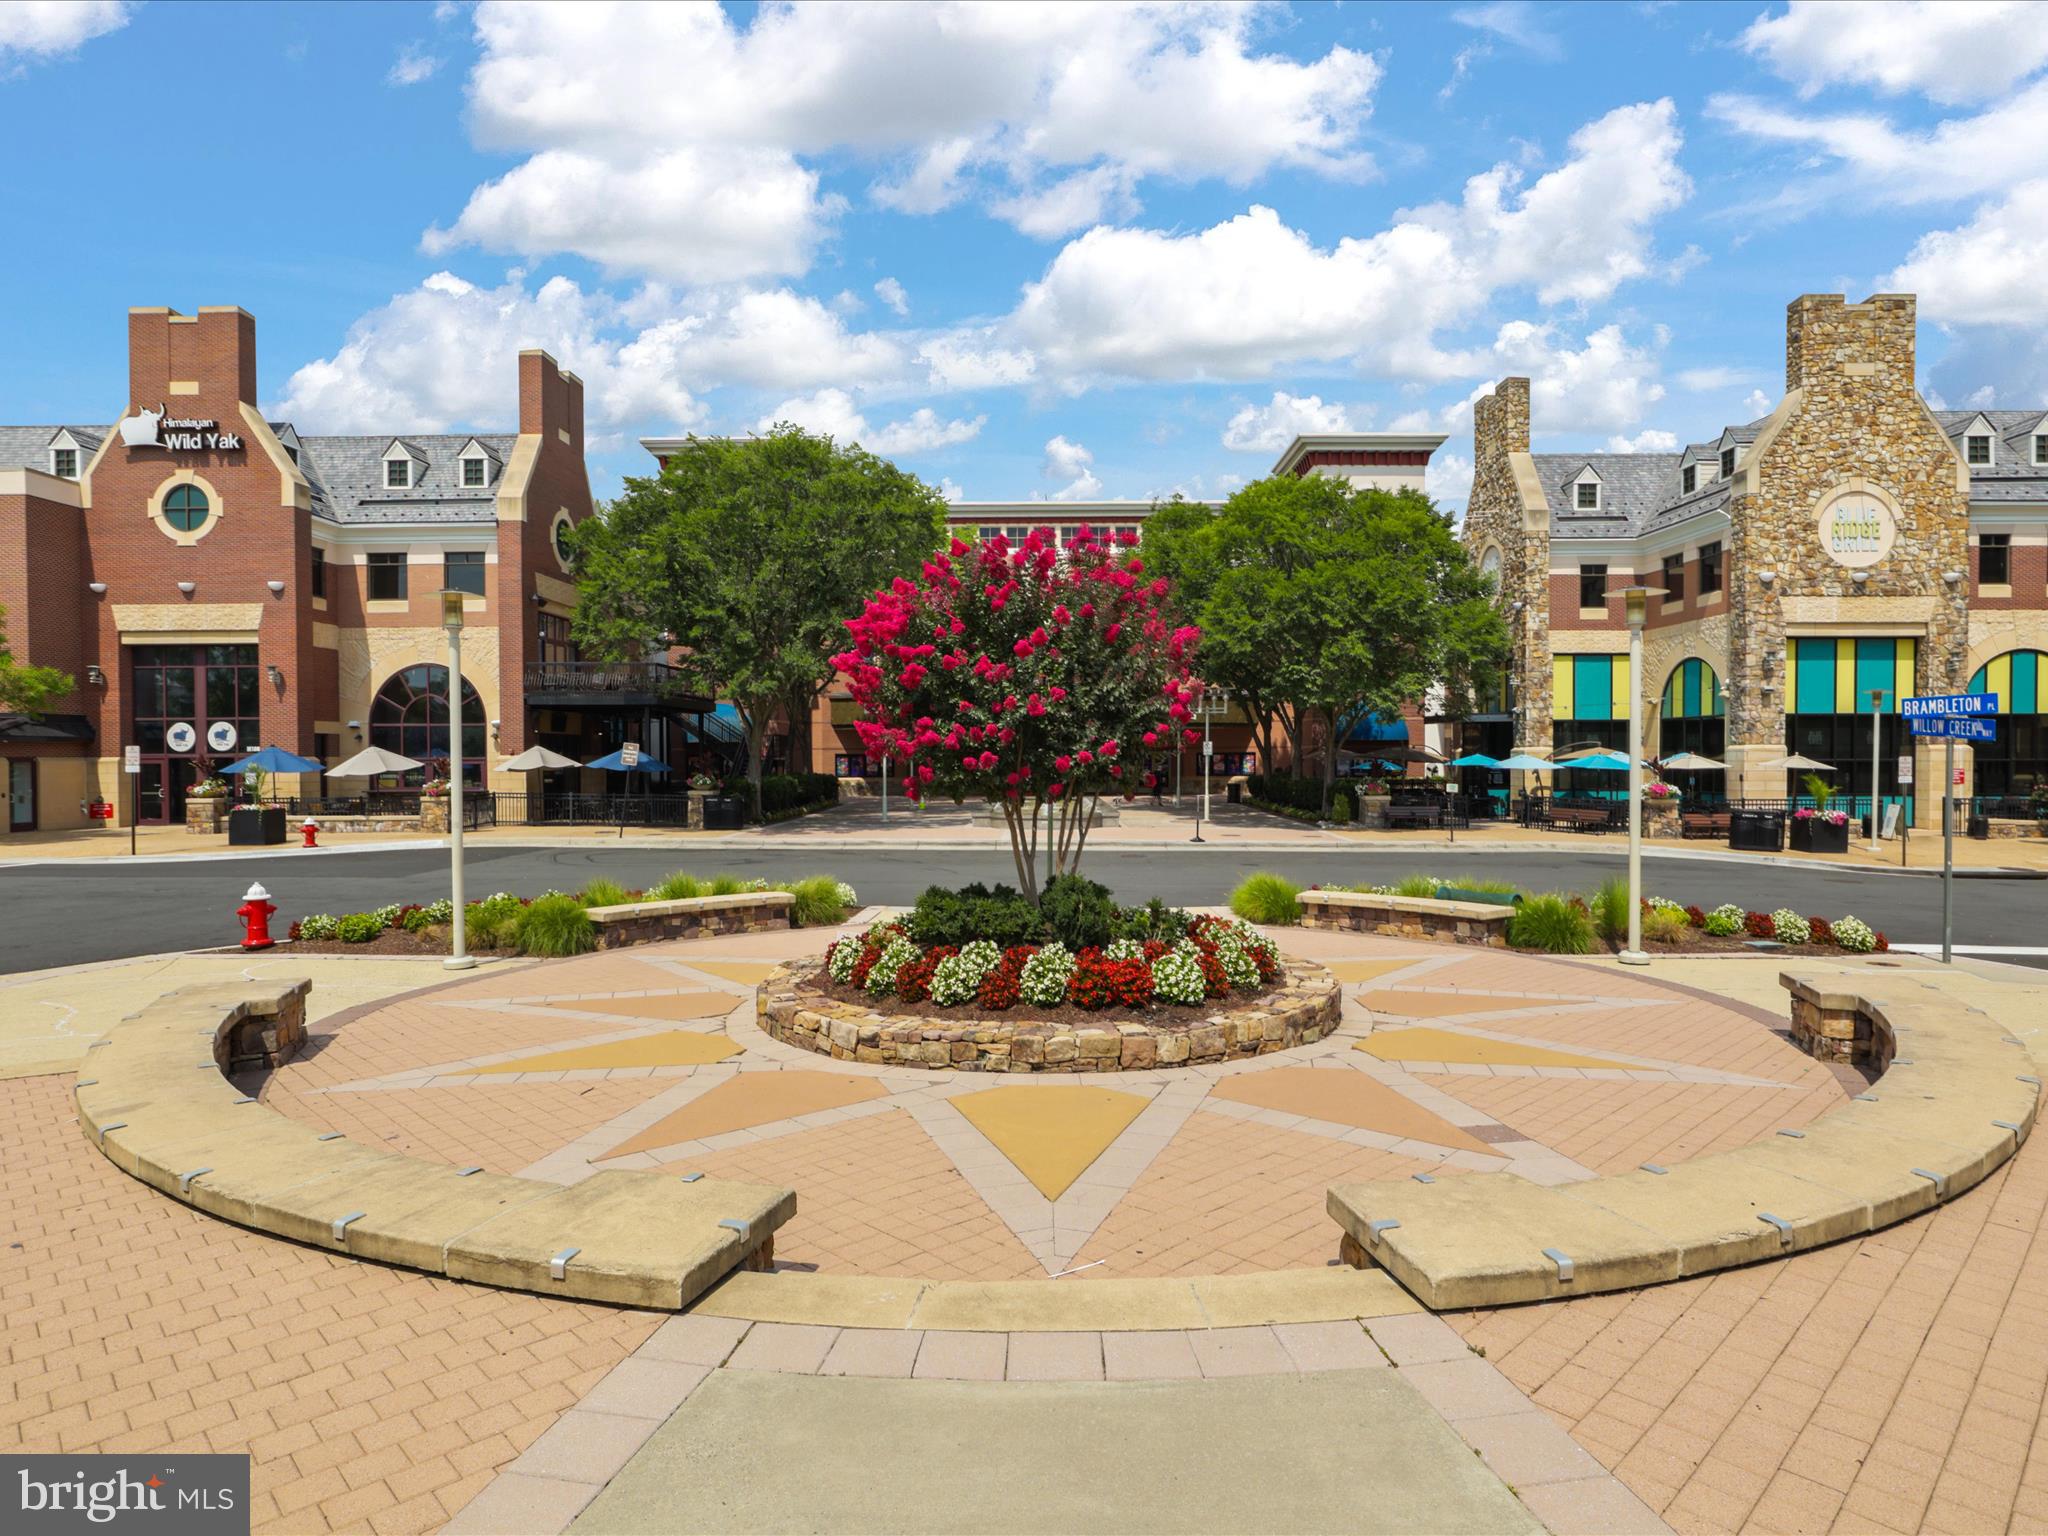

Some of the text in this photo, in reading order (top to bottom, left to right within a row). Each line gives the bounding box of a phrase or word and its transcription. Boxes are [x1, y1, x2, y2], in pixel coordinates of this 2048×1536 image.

[163, 418, 213, 430] Himalayan
[164, 432, 240, 449] Wild Yak
[1832, 521, 1880, 539] RIDGE
[1904, 697, 1981, 716] BRAMBLETON
[1913, 718, 1945, 734] WILLOW
[1949, 720, 1977, 736] CREEK
